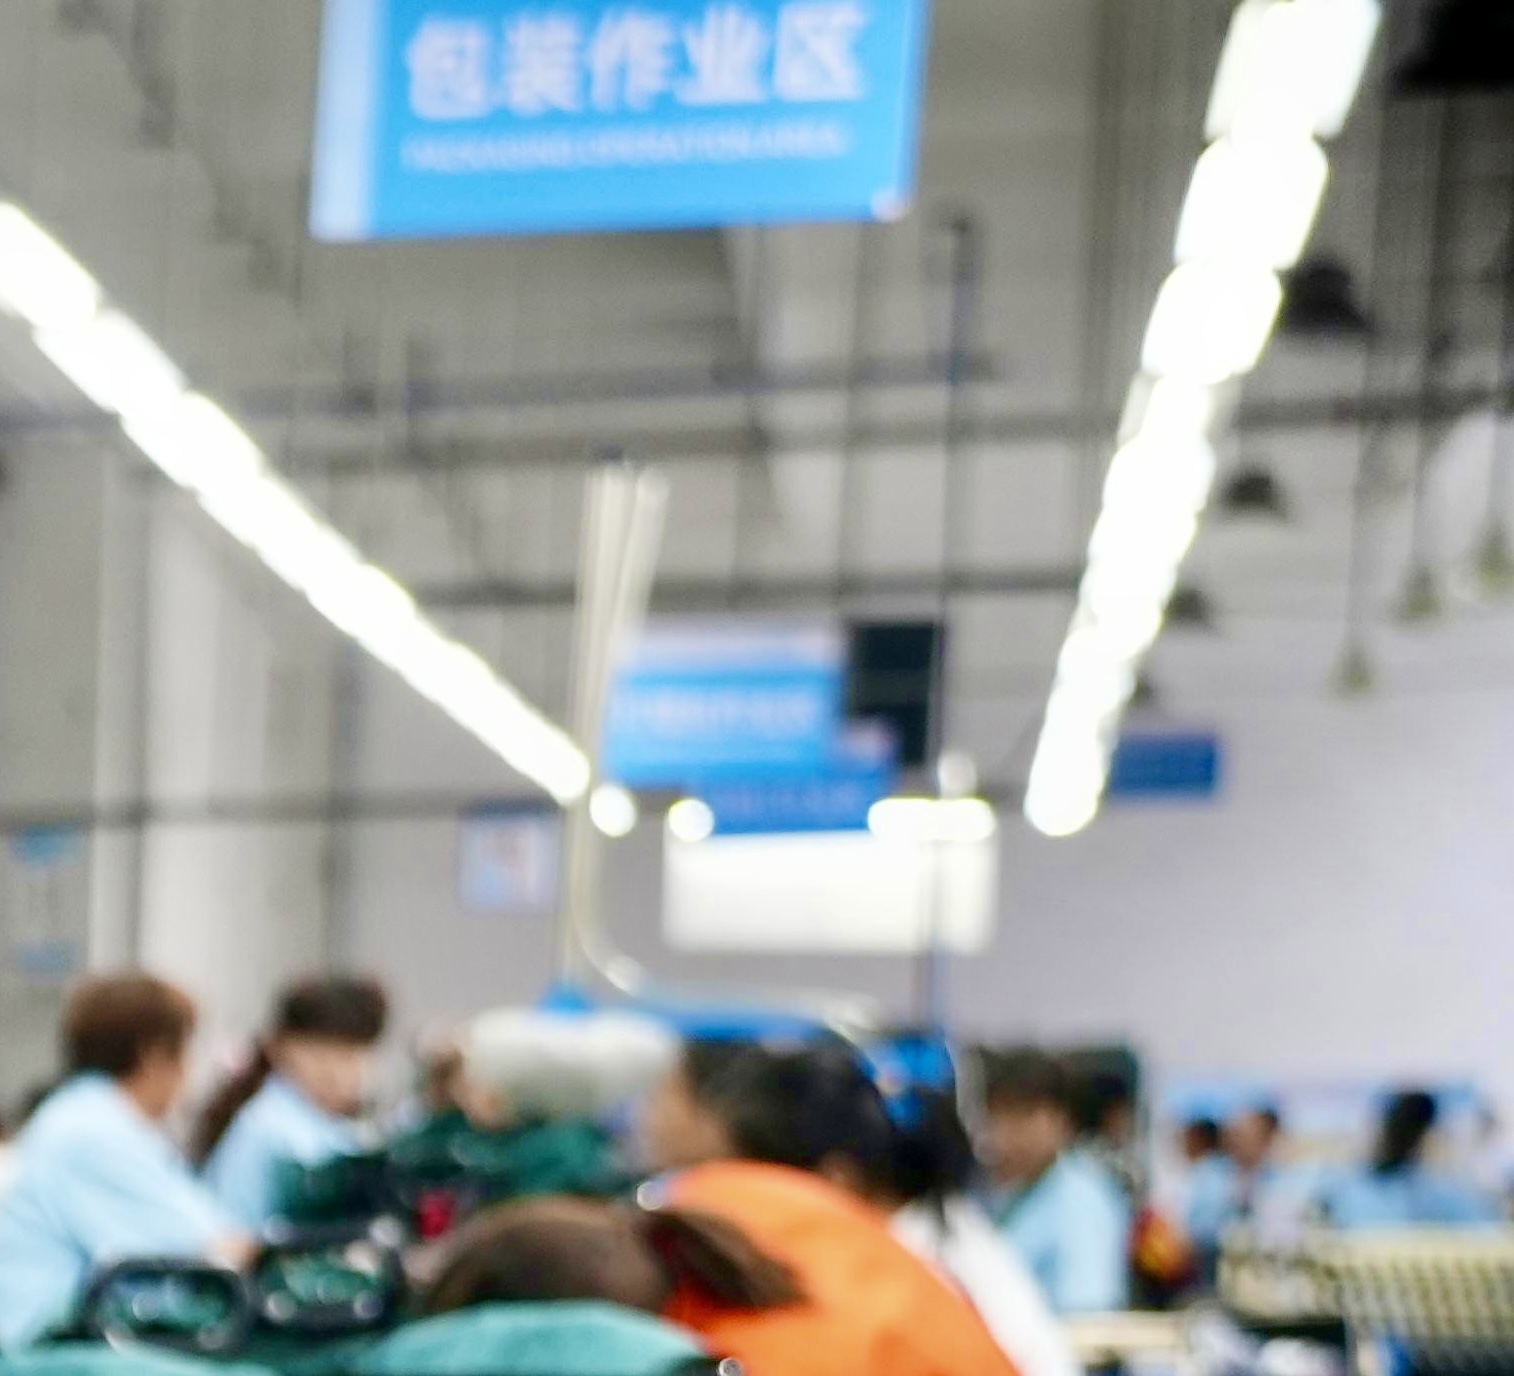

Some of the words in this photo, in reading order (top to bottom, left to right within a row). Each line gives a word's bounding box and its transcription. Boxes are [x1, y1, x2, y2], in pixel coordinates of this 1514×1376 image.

[406, 2, 864, 119] 包装作业区
